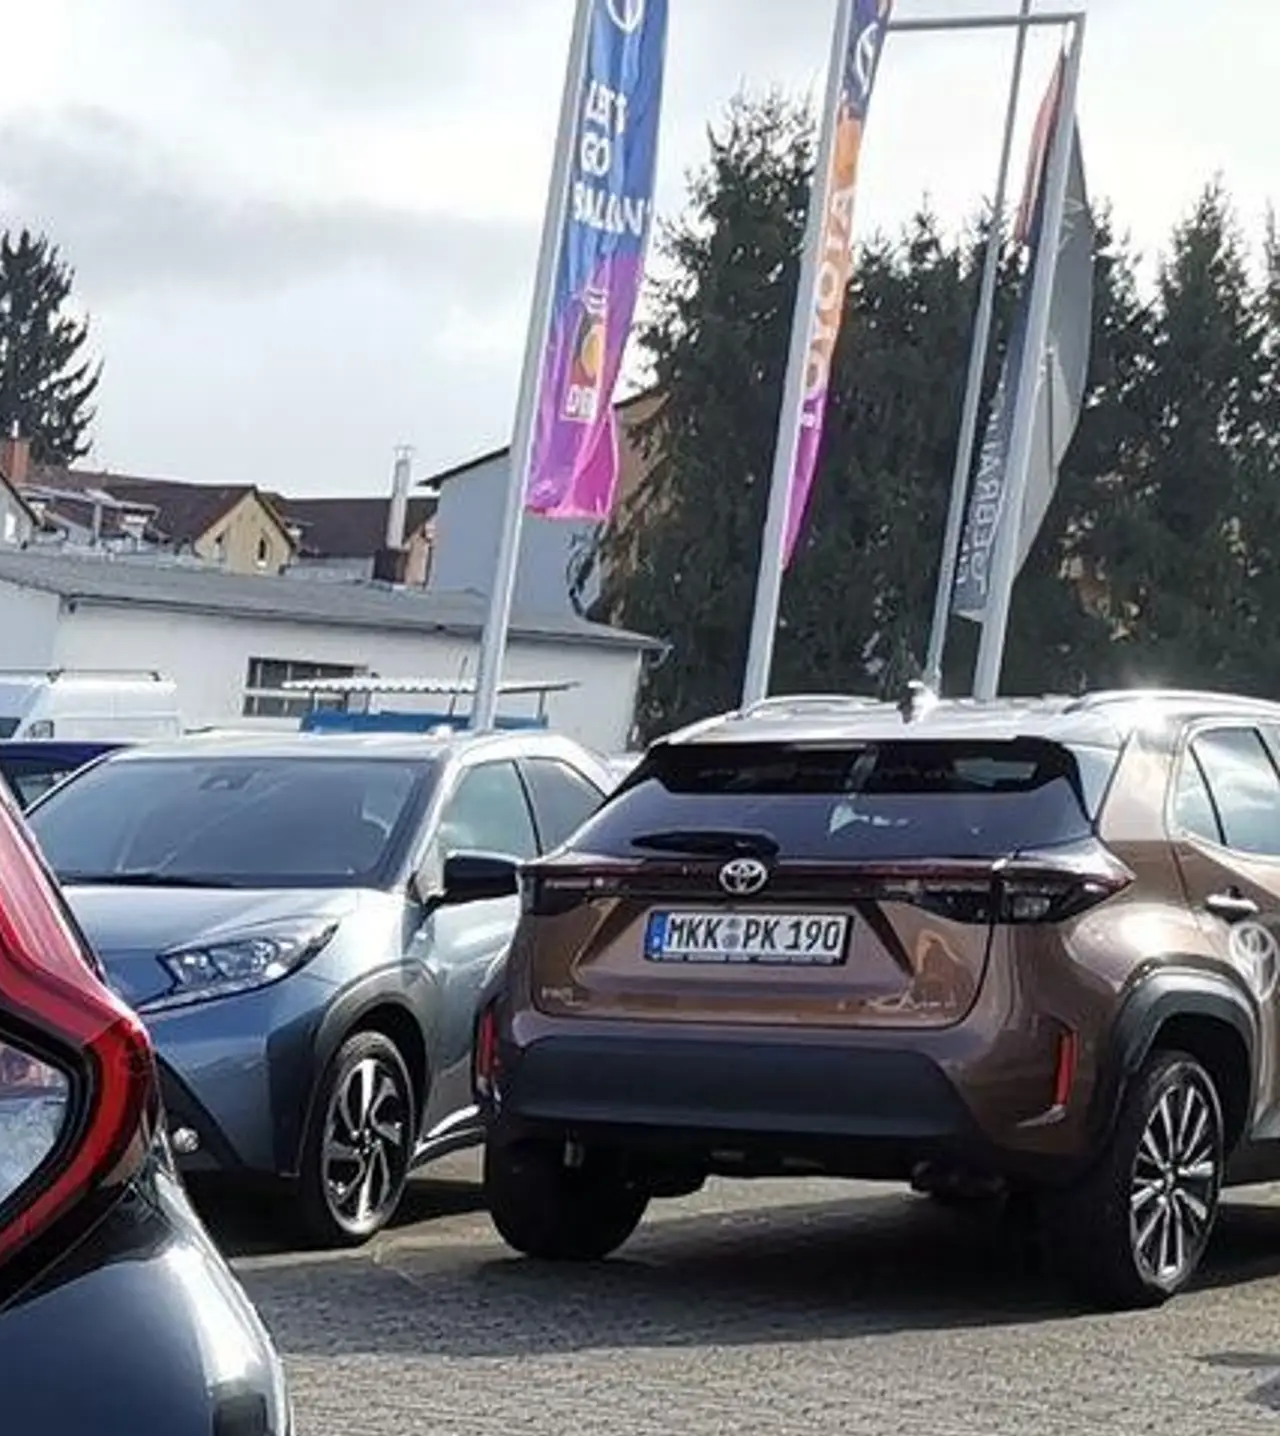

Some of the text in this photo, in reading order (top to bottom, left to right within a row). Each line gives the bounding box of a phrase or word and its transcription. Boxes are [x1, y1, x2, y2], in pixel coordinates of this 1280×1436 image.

[669, 917, 841, 951] MKK PK 190
